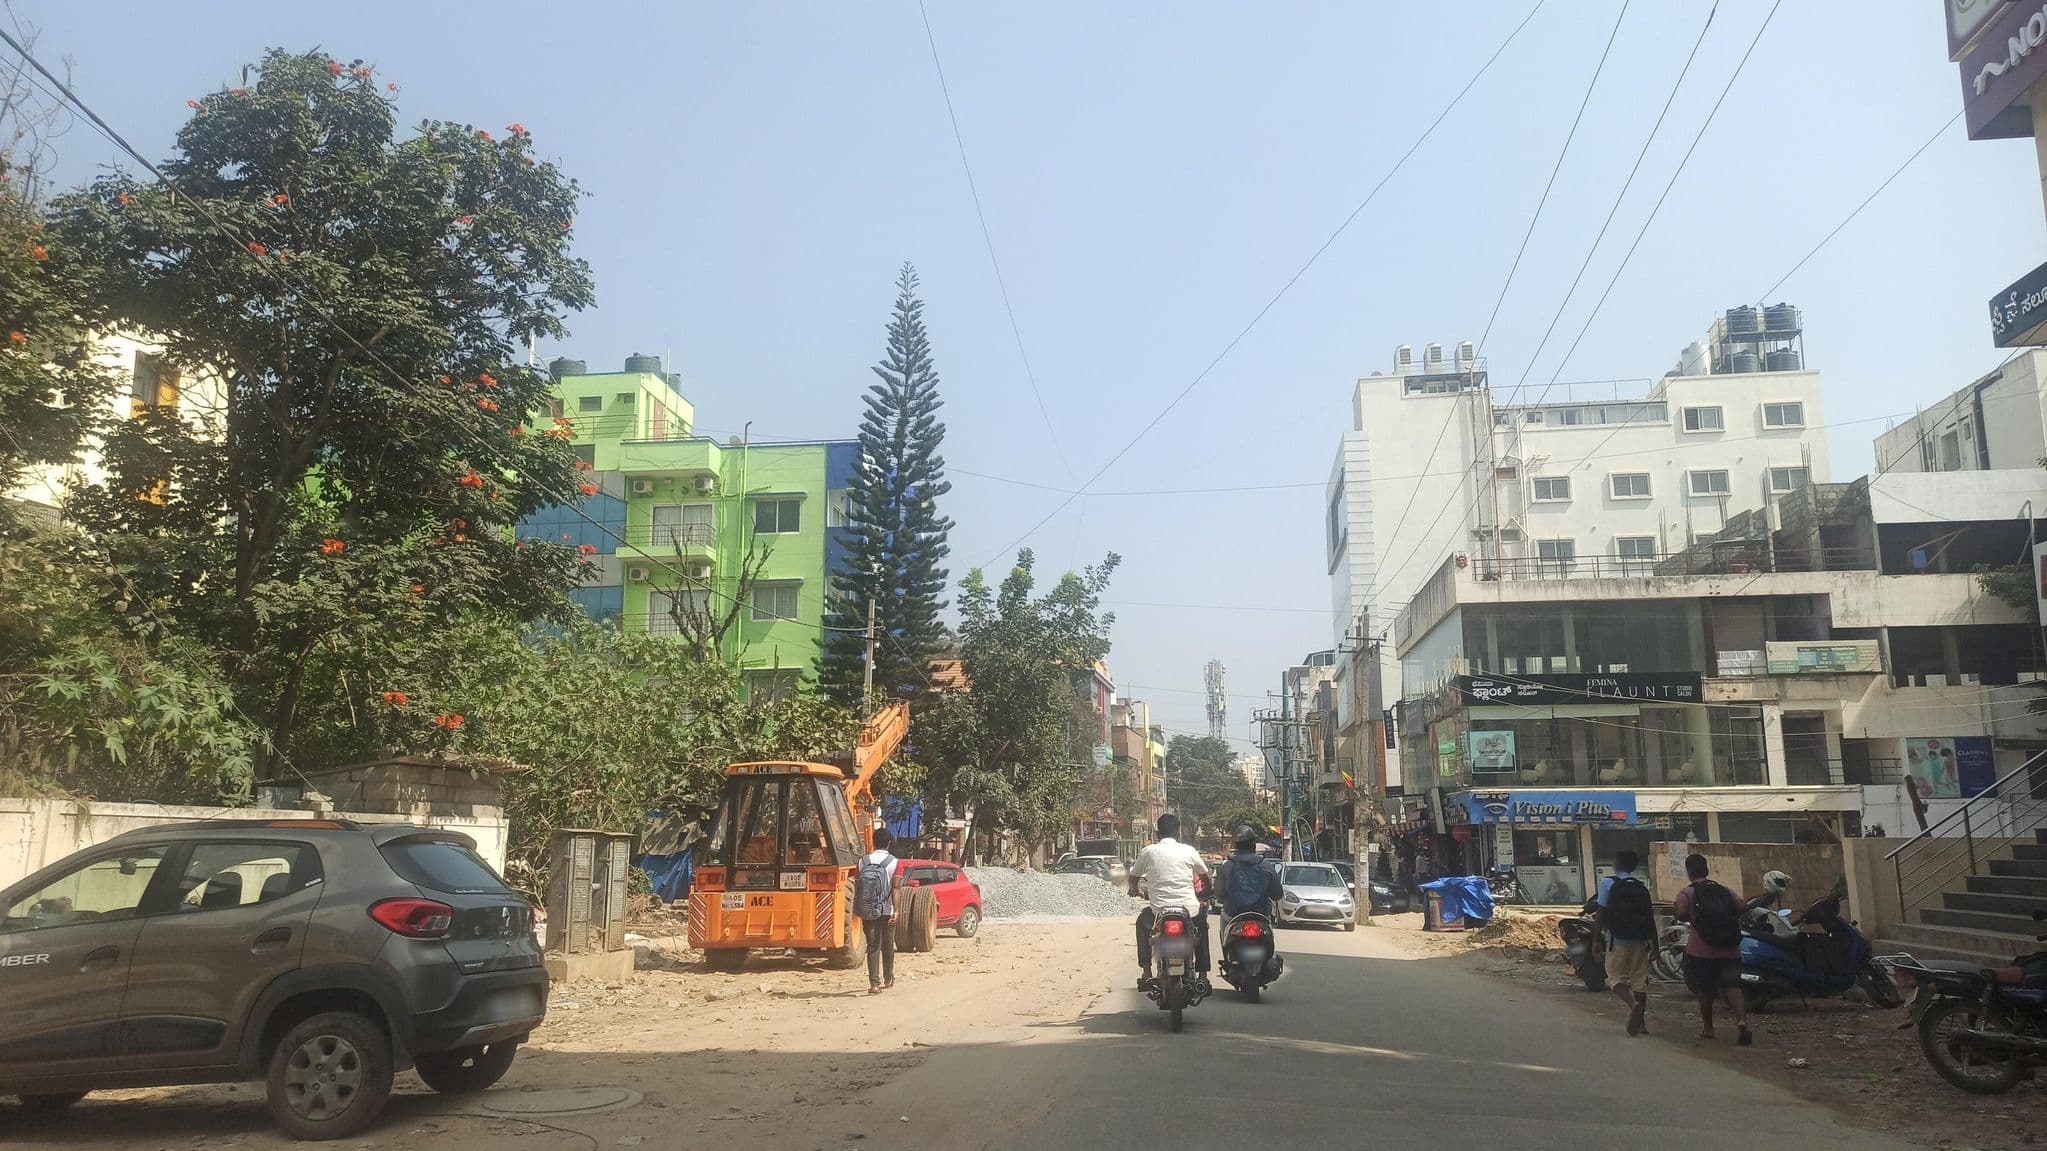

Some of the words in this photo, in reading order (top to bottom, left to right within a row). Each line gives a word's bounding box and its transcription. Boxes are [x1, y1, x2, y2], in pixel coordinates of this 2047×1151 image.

[2008, 4, 2047, 66] NO
[1586, 686, 1670, 698] FLAUNT
[752, 765, 773, 774] ACE
[1514, 800, 1562, 815] Vision
[1567, 800, 1574, 815] i
[1576, 800, 1611, 815] Plus
[751, 896, 774, 907] ACE
